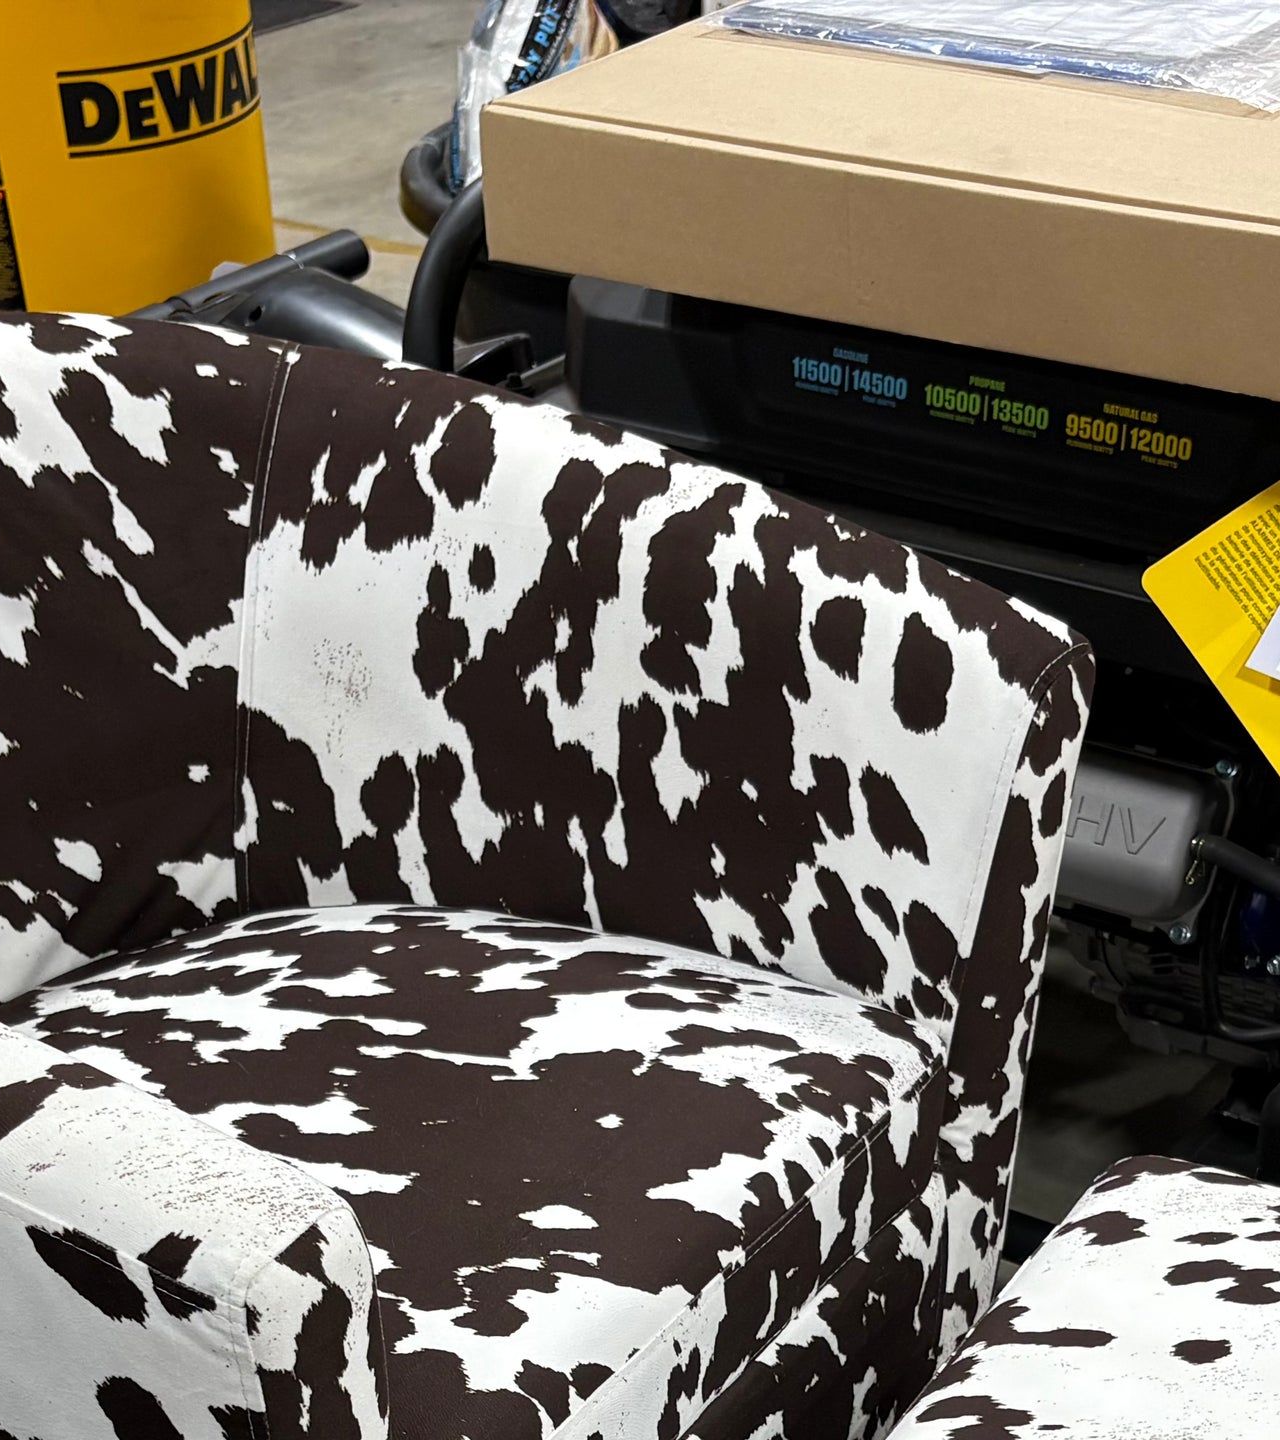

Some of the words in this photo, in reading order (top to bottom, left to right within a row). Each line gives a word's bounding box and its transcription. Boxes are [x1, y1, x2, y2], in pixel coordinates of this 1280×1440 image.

[58, 35, 259, 146] DEWAL
[792, 356, 842, 387] 11500
[852, 367, 908, 400] 14500
[924, 382, 982, 416] 10500
[991, 397, 1050, 431] 13500
[1065, 413, 1119, 445] 9500
[1129, 426, 1192, 461] 12000
[1066, 795, 1167, 856] HV
